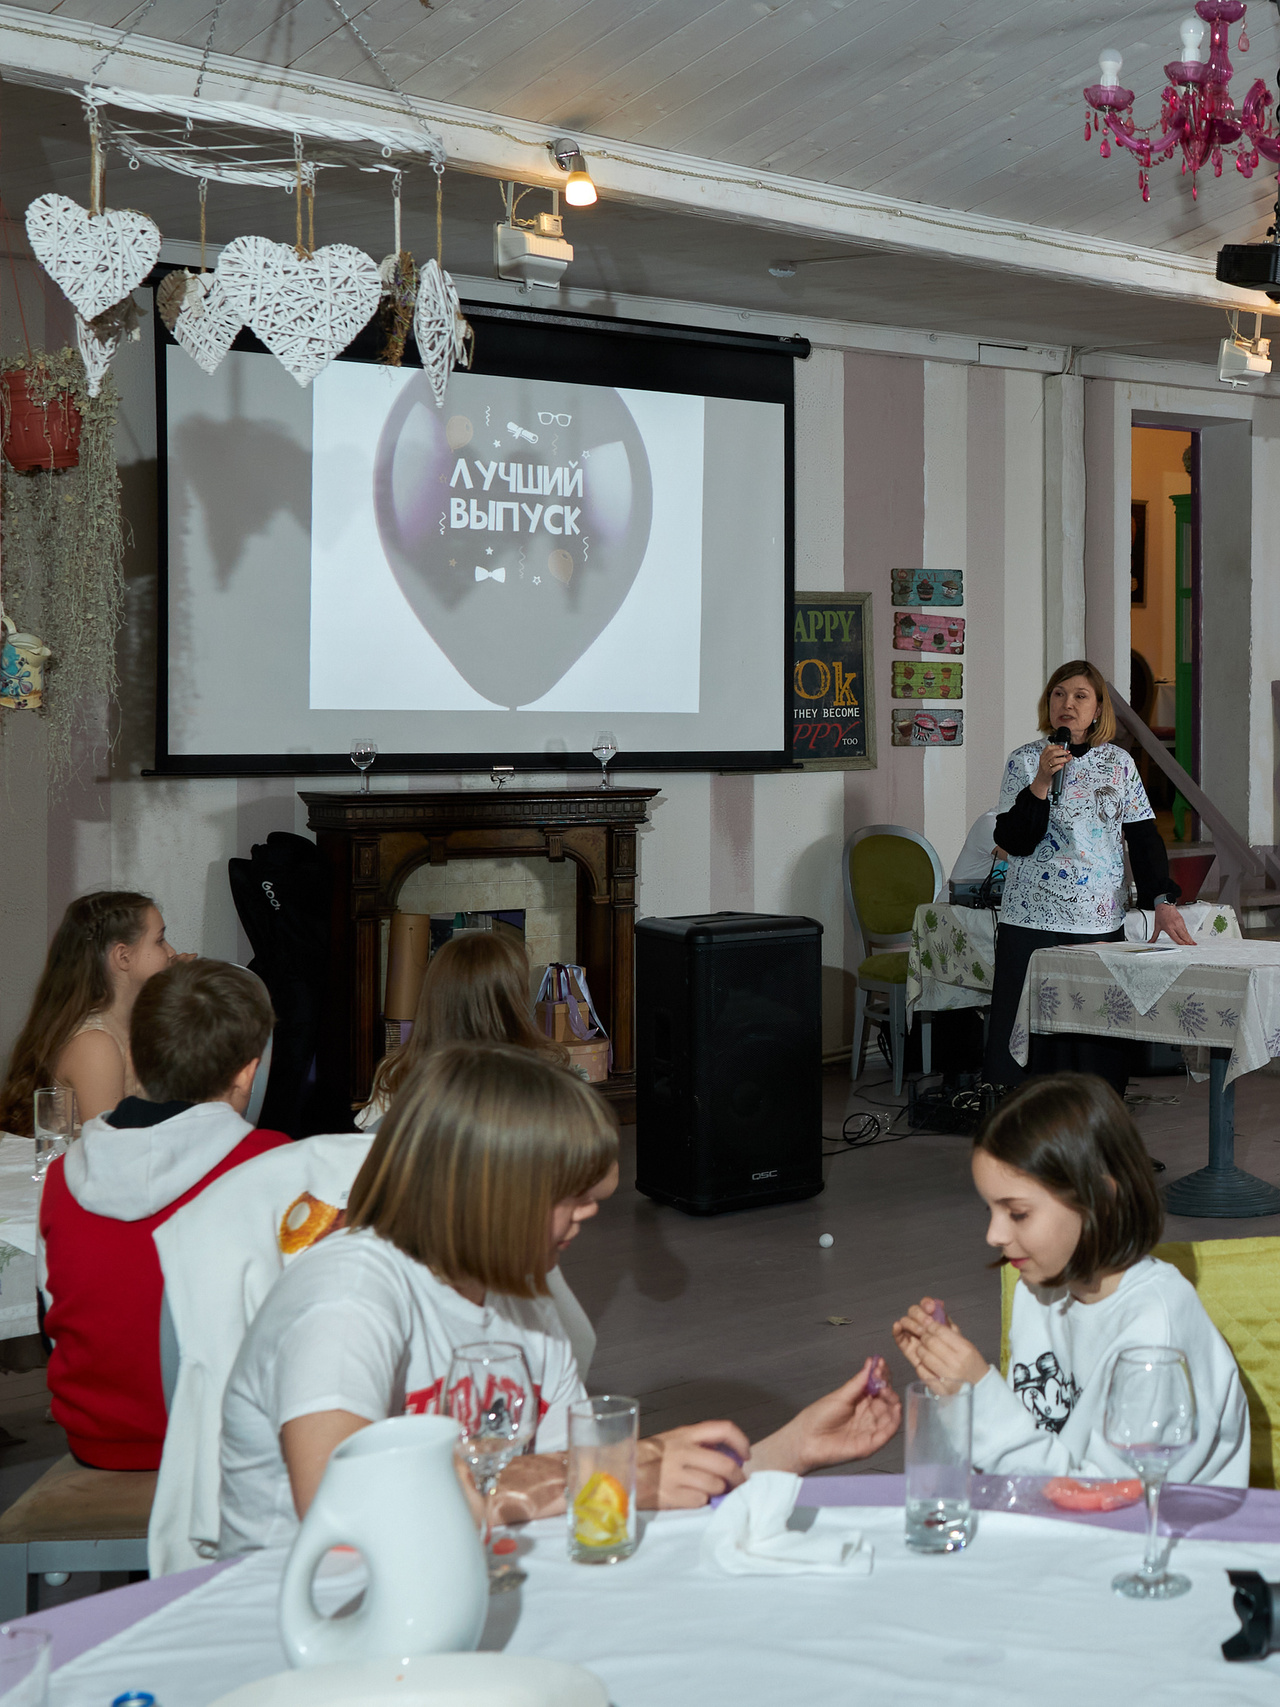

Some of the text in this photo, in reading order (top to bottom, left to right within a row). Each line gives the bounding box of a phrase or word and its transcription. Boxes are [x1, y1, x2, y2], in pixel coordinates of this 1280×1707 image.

[450, 458, 583, 497] ЛУЧШИЙ
[450, 498, 581, 535] ВЫПУСК
[794, 609, 855, 642] APPY
[794, 707, 860, 718] THEY BECOME
[752, 1170, 778, 1180] QSC
